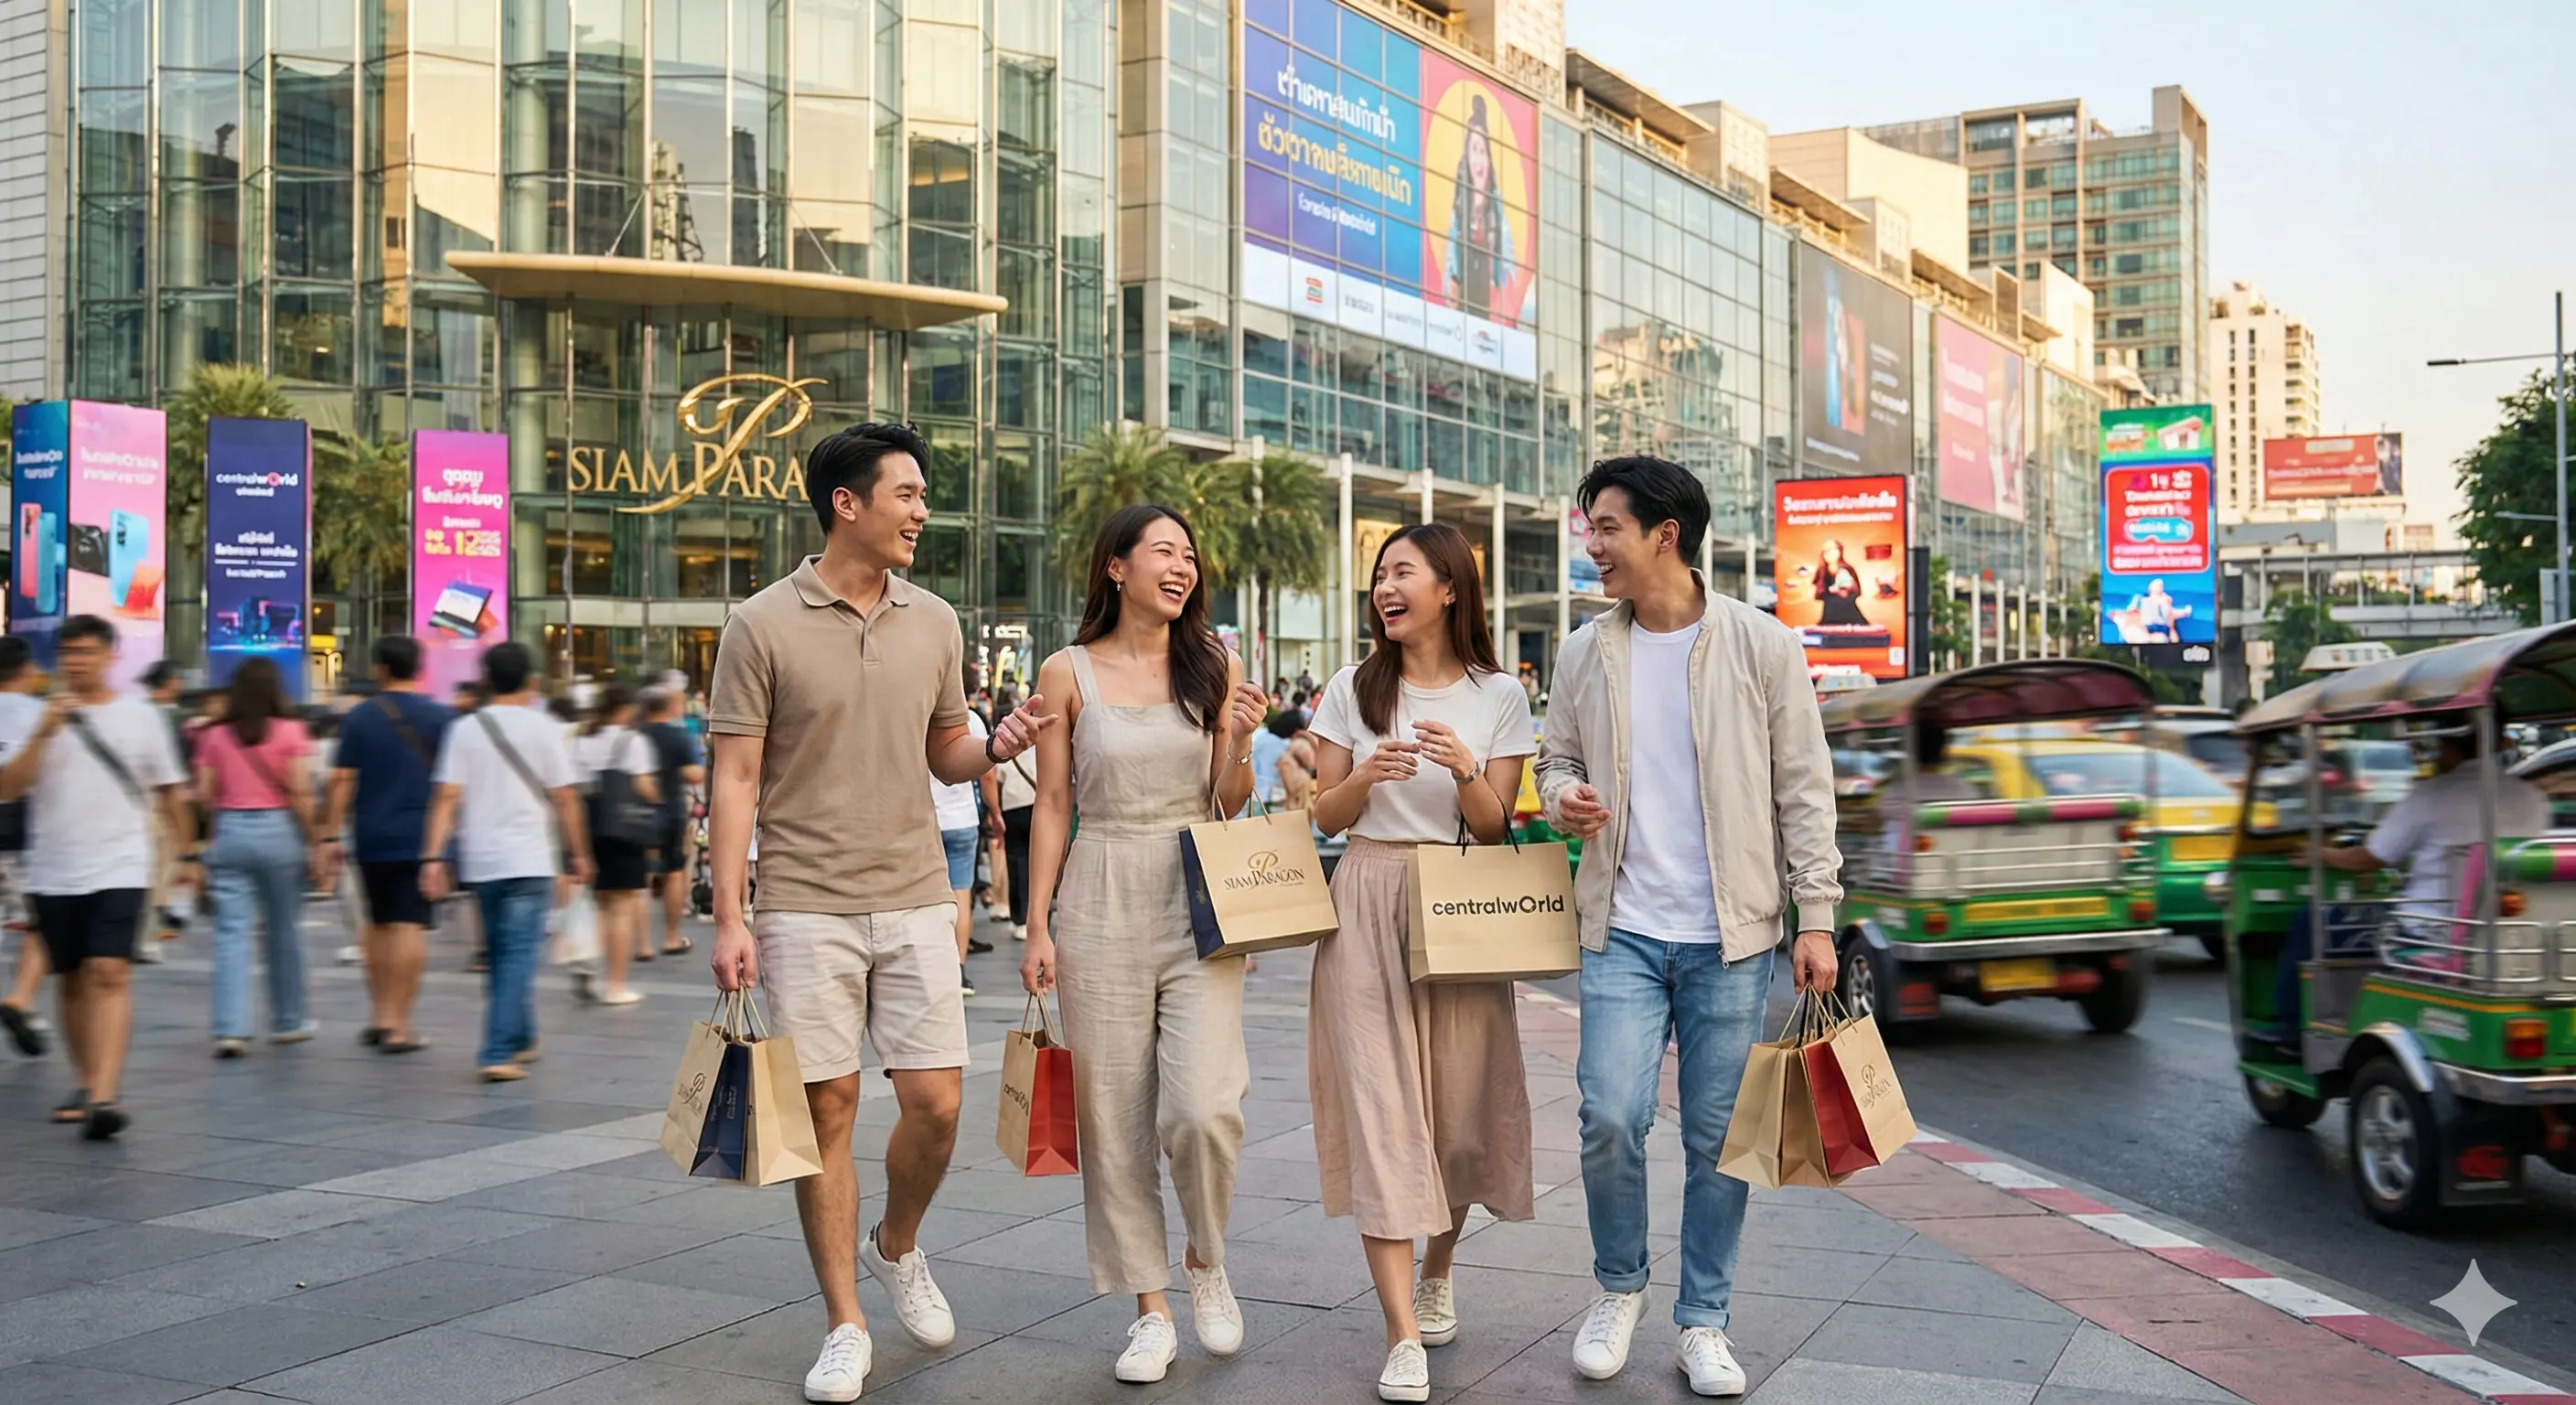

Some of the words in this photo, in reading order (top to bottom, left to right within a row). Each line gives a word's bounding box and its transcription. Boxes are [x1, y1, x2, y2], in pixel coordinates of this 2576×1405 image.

[568, 445, 682, 495] SIAM
[691, 441, 810, 502] PARA
[1223, 874, 1252, 891] SIAM
[1432, 895, 1565, 916] centralwOrld
